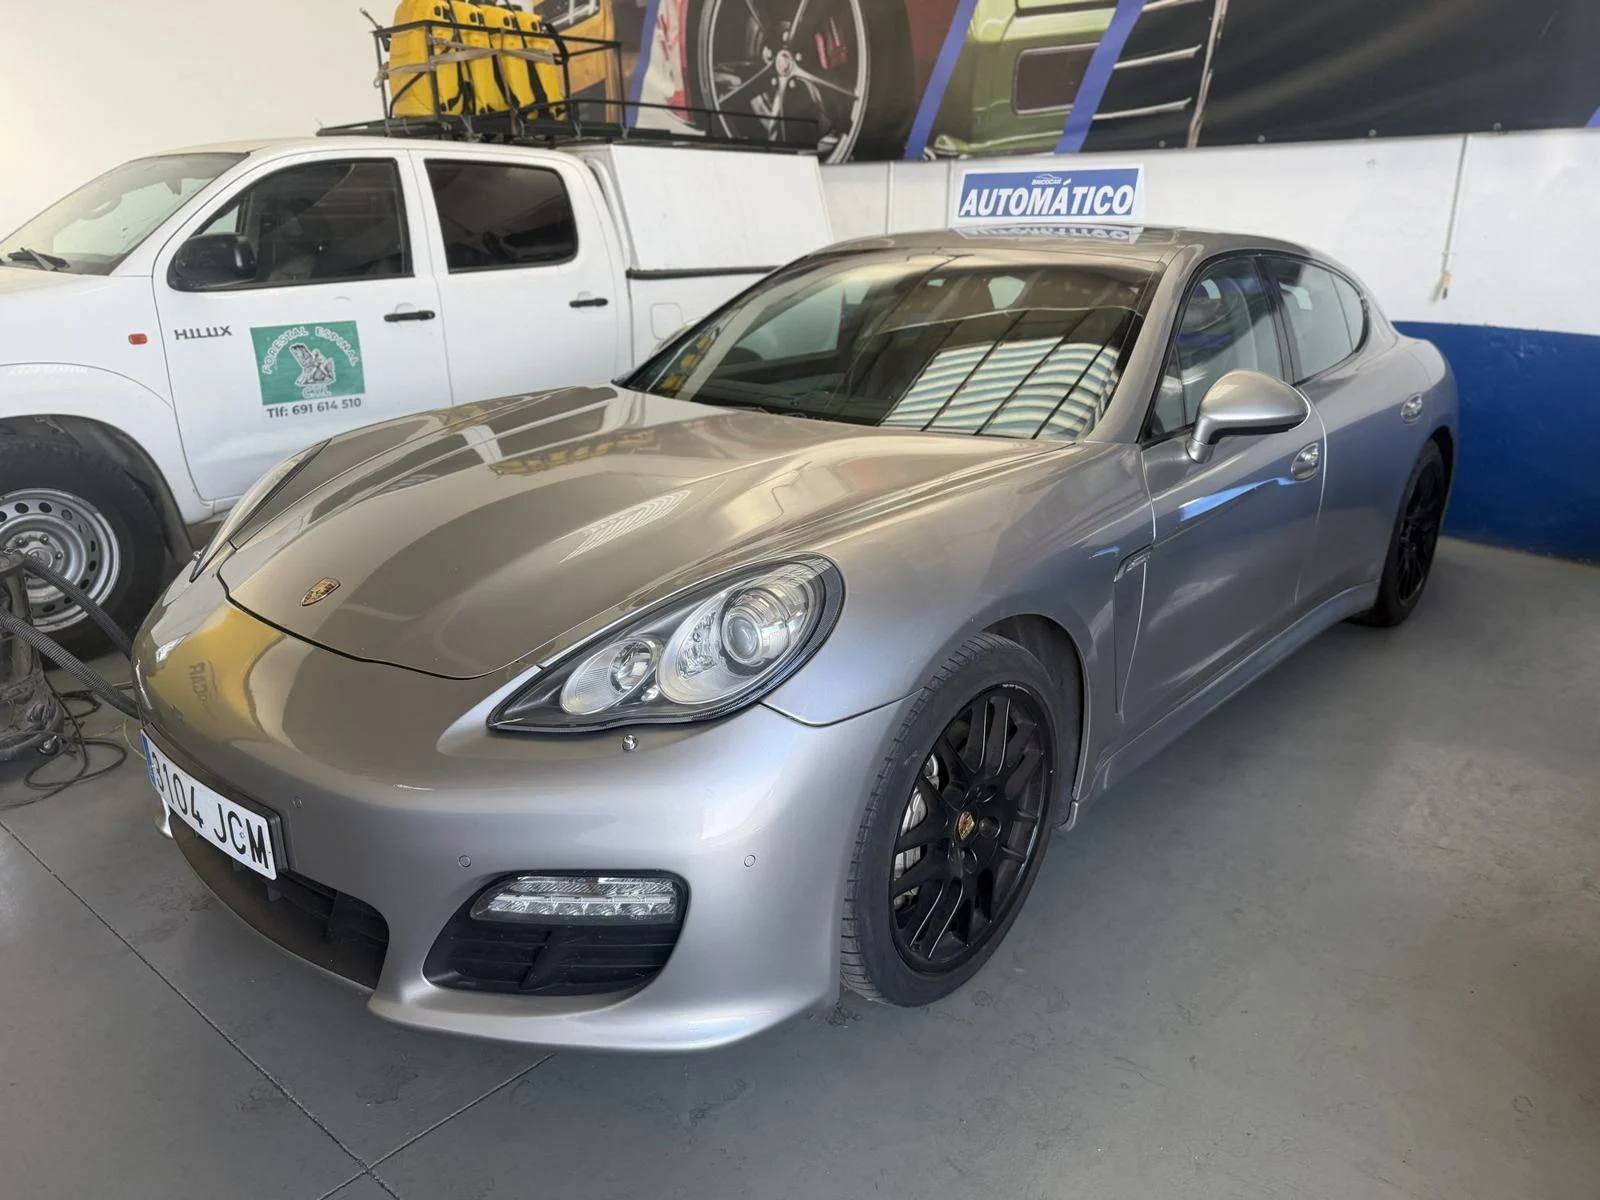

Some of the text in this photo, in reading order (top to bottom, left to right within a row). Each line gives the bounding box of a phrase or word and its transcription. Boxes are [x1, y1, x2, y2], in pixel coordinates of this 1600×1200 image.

[959, 177, 1135, 217] AUTOMÁTICO
[174, 325, 232, 340] HILUX
[262, 325, 360, 375] FORESTAL ESPINAL
[292, 404, 313, 416] 691
[317, 400, 338, 412] 614
[342, 398, 362, 409] 510
[152, 751, 270, 870] 3104 JCM
